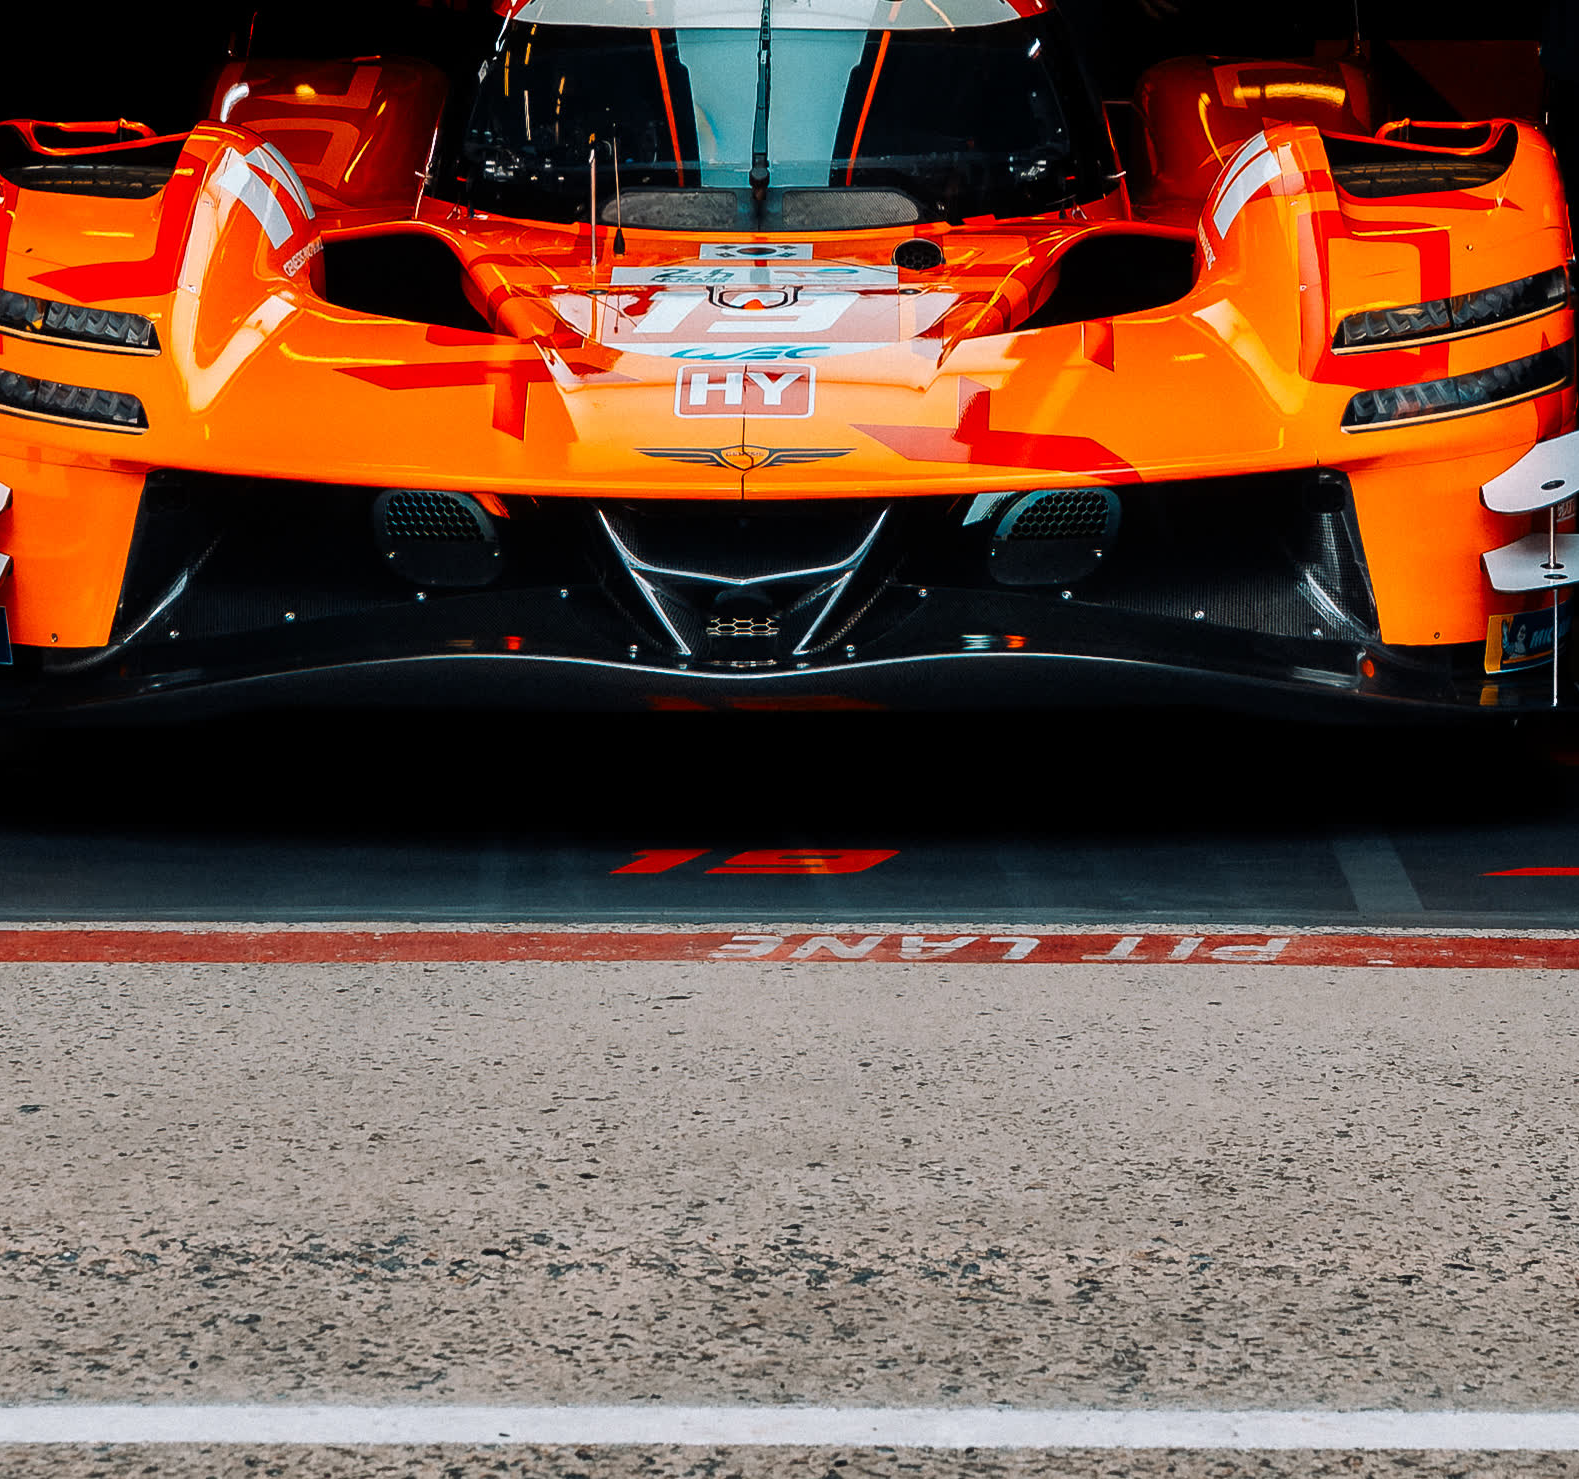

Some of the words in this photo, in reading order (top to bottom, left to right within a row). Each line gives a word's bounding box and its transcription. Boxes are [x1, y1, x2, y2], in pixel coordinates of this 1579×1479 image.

[633, 291, 860, 333] 19
[688, 372, 802, 405] HY
[609, 849, 902, 874] 19
[709, 935, 1040, 960] LANE
[1080, 937, 1290, 961] PIT
